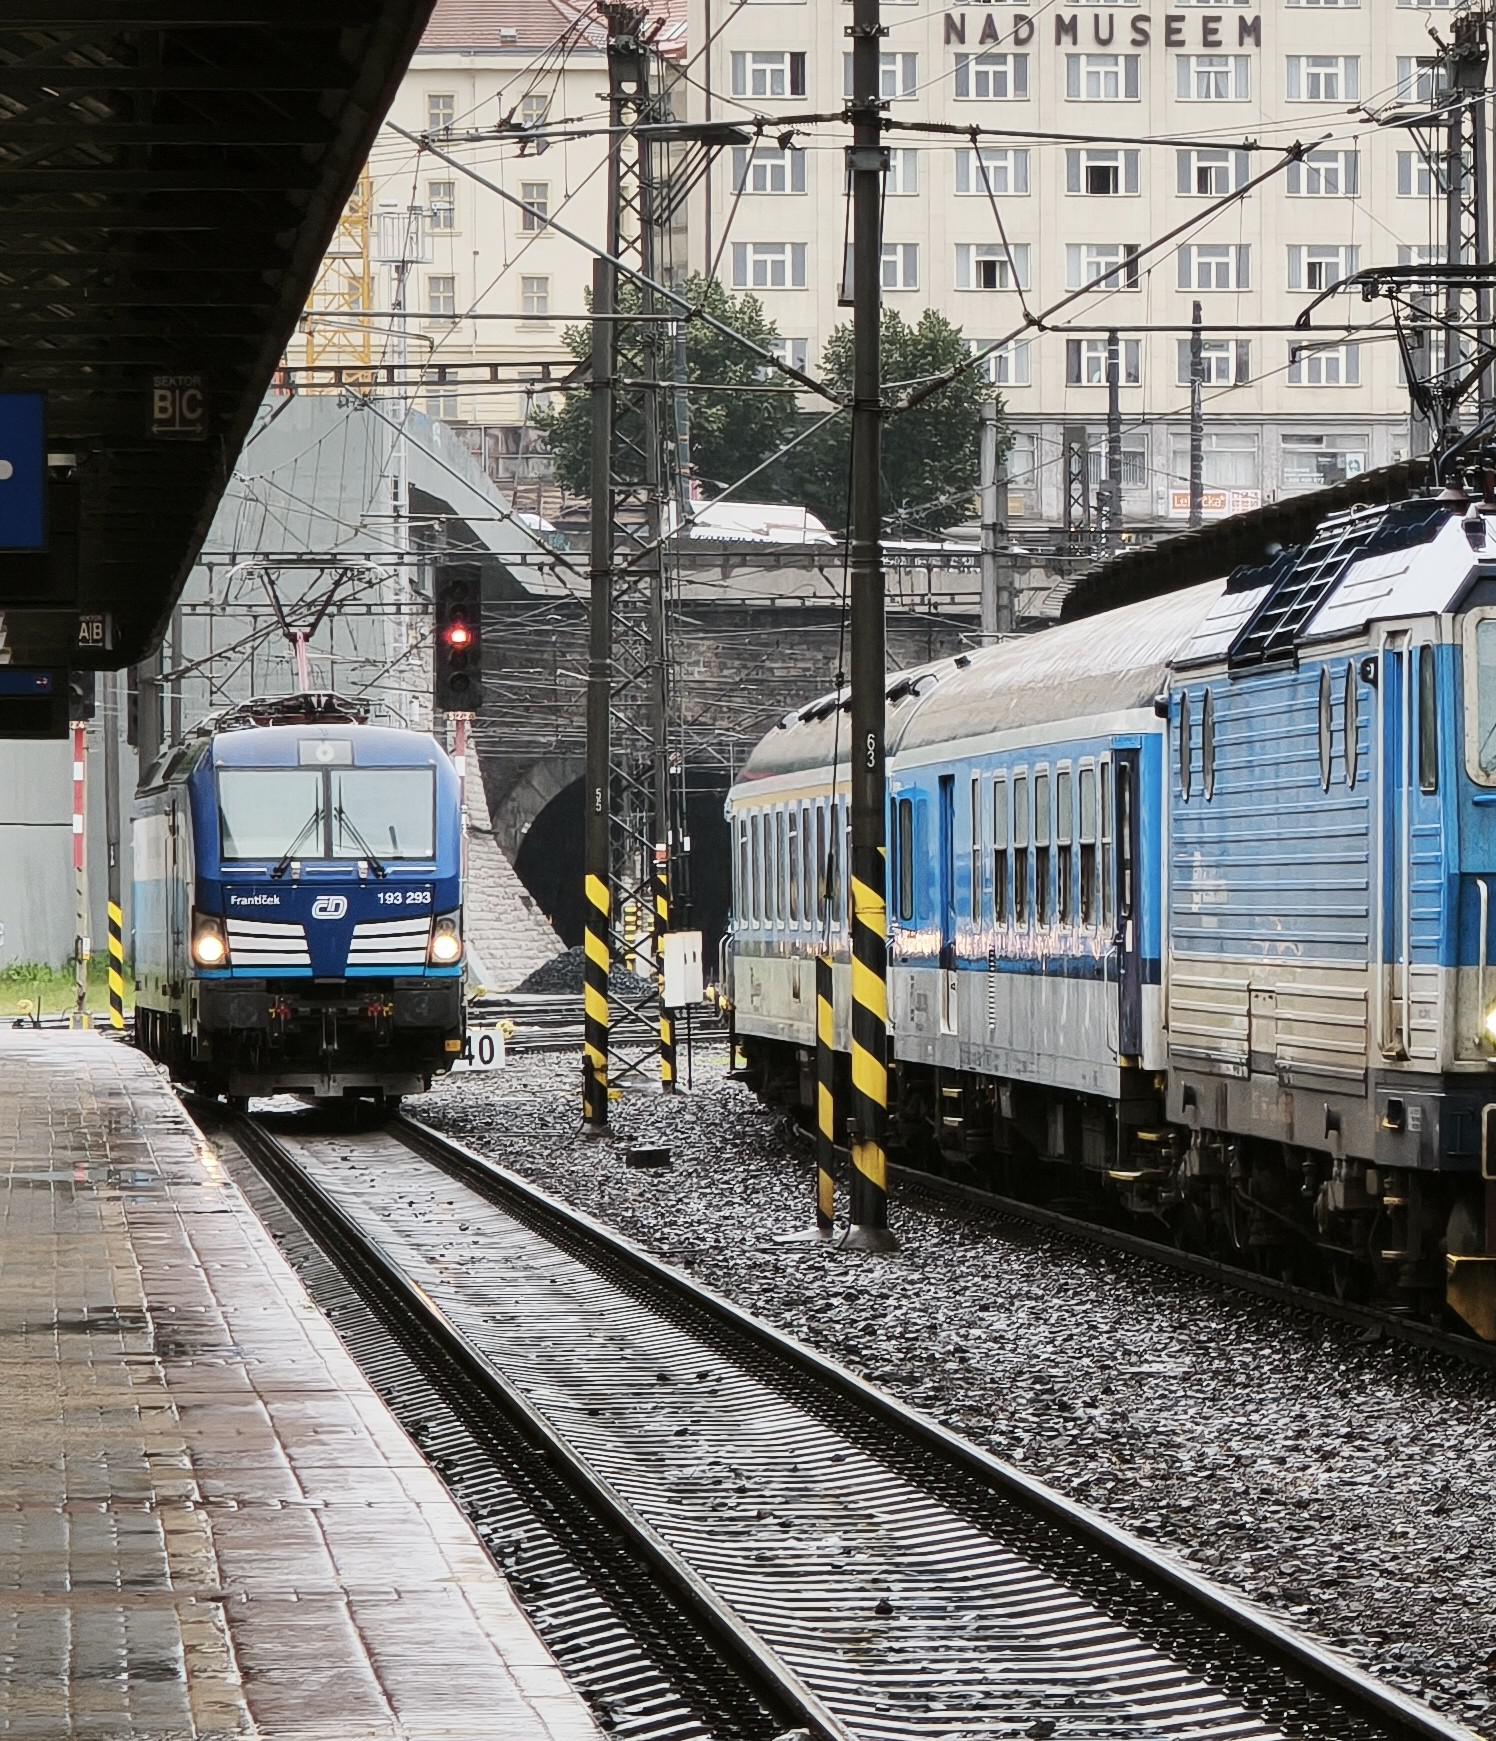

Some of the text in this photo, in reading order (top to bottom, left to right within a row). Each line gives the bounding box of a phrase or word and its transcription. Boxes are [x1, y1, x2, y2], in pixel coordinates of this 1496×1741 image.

[944, 13, 1261, 48] NAD MUSEEM
[866, 733, 876, 768] 63
[377, 892, 403, 905] 193
[405, 891, 431, 905] 293
